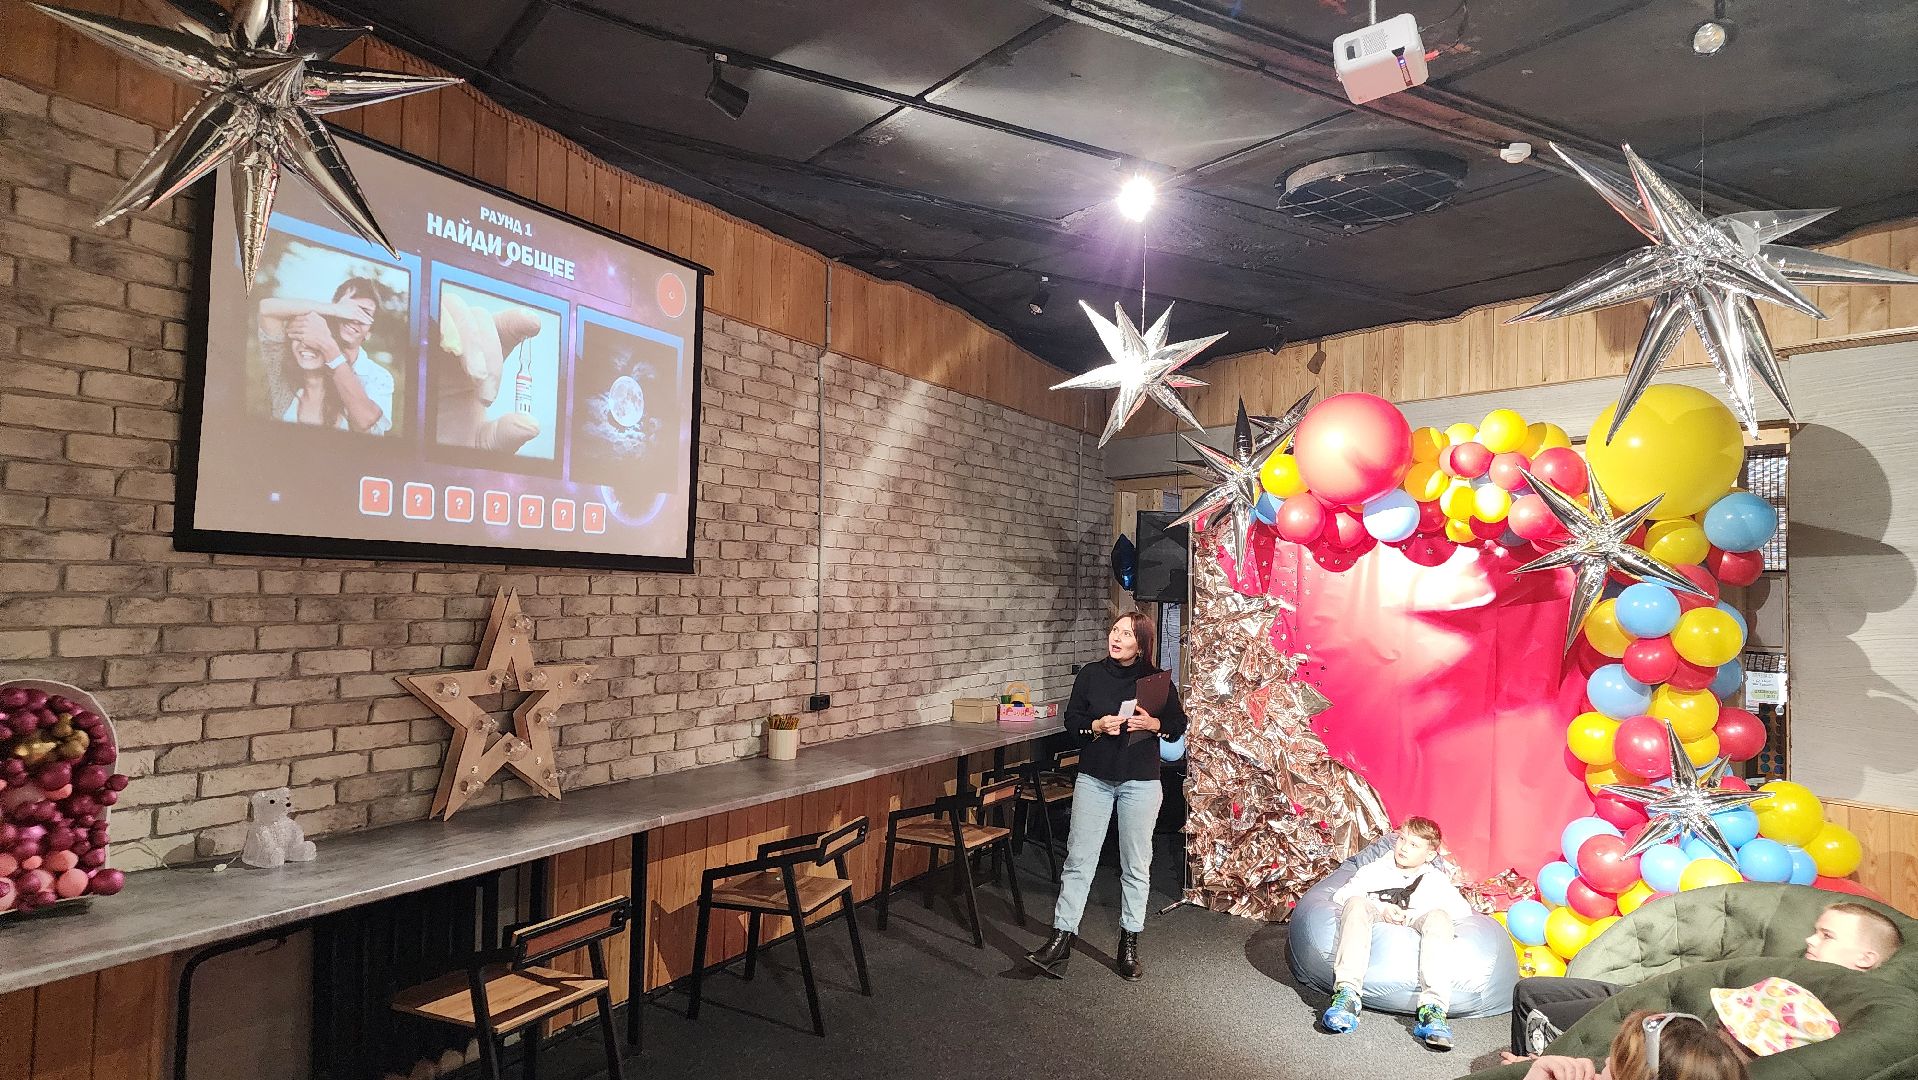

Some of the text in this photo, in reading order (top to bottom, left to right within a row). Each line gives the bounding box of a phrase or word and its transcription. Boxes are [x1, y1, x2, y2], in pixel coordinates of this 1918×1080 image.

[480, 206, 533, 237] РАУНД 1
[427, 212, 576, 281] НАЙДИ ОБЩЕЕ
[371, 489, 597, 523] ? ? ? ? ? ? ?
